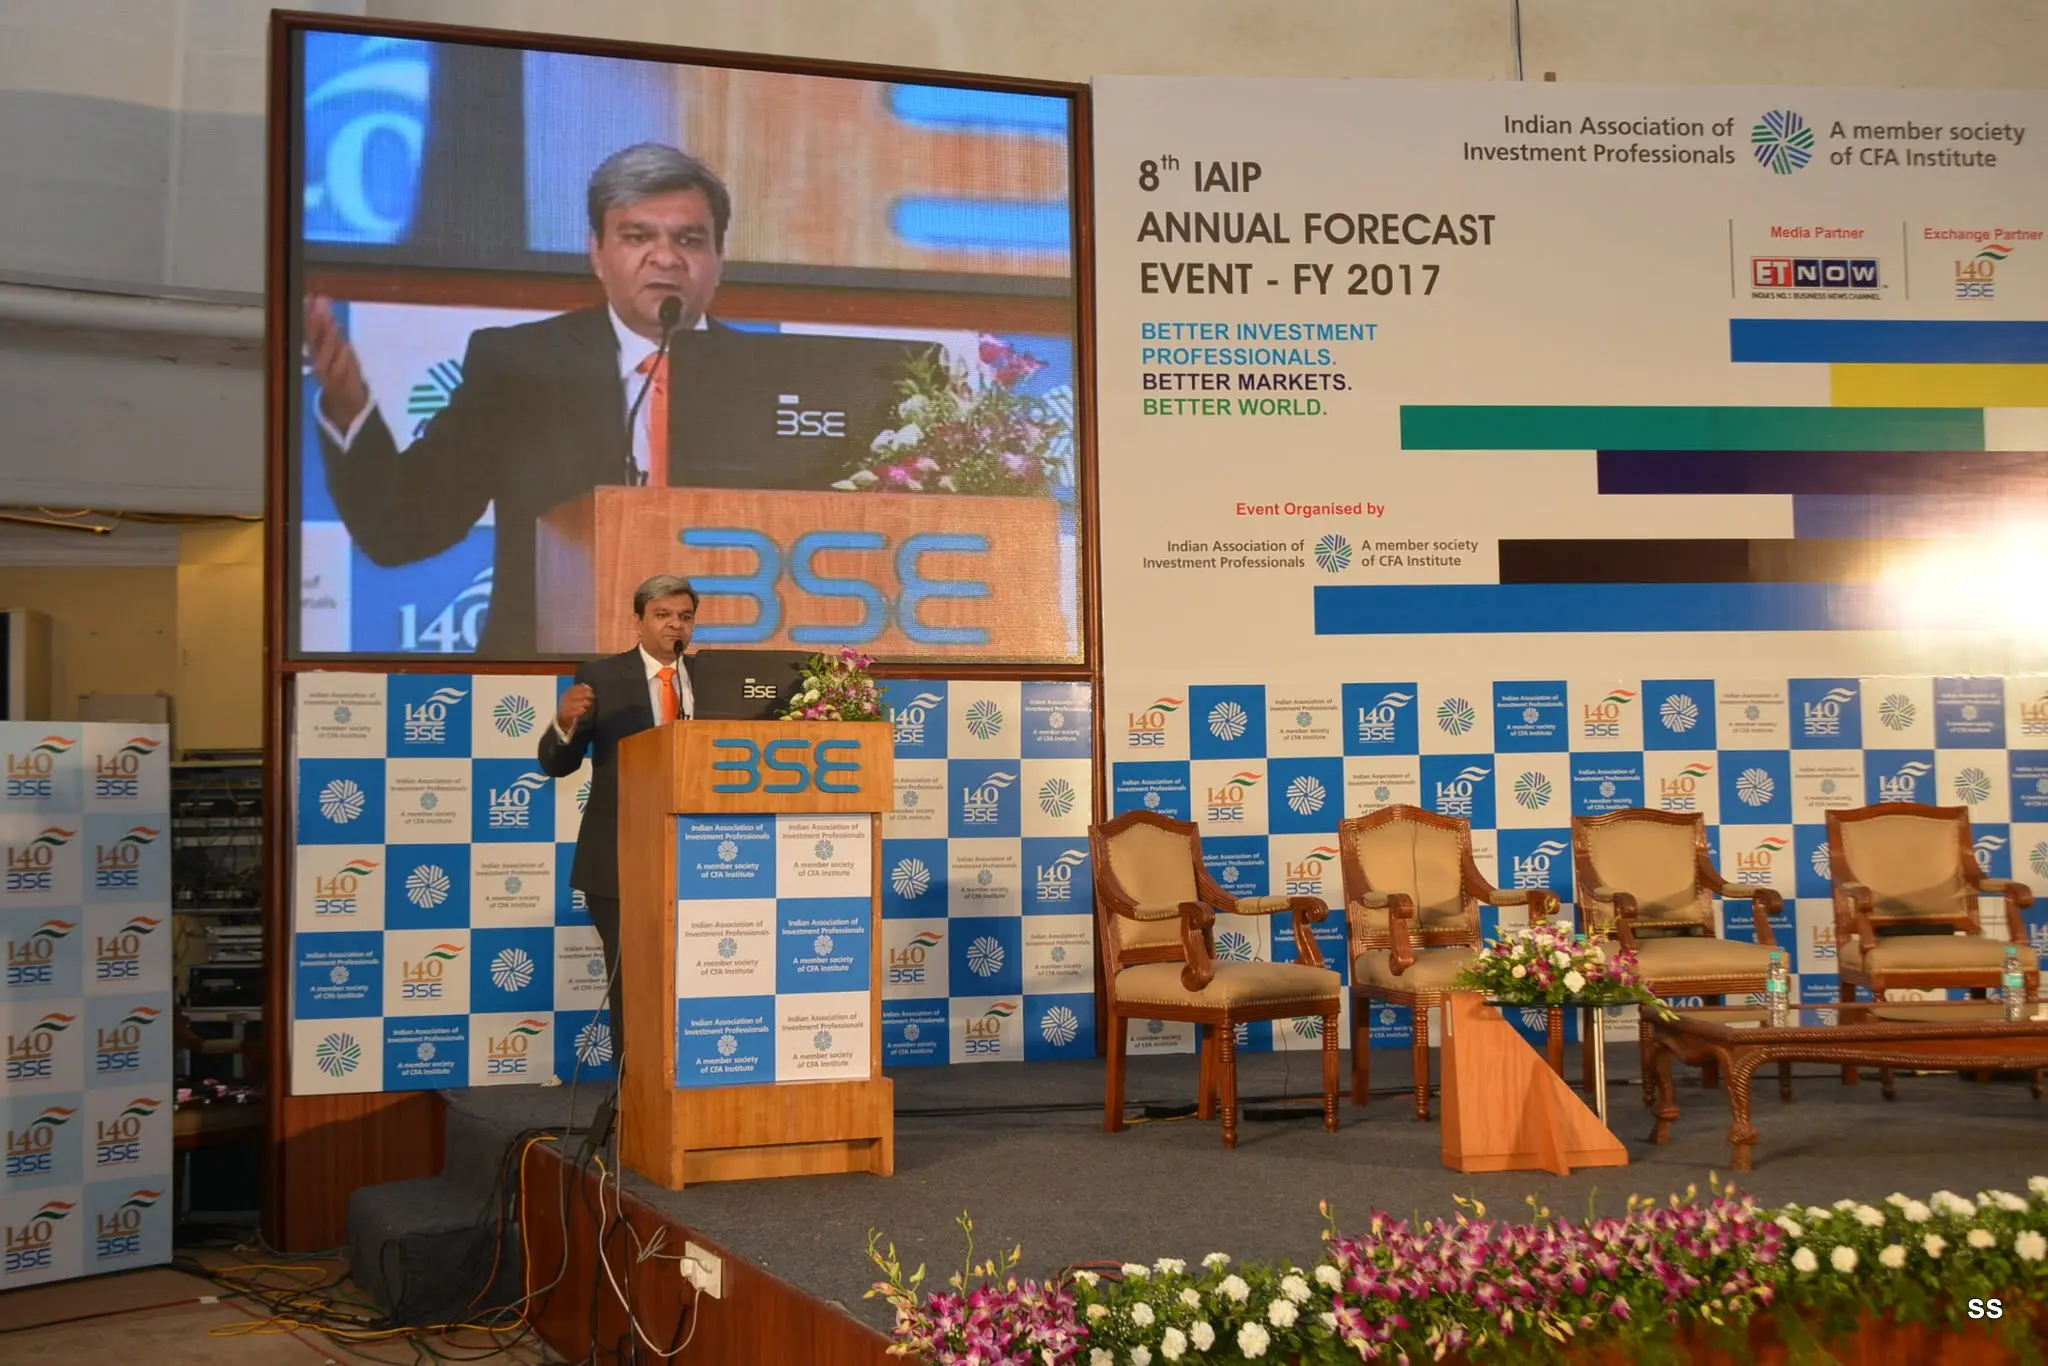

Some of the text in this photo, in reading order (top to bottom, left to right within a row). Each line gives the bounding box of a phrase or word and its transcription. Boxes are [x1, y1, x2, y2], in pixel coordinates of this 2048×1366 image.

[1504, 115, 1734, 136] Indian Association of
[1829, 121, 2026, 145] A member society
[1463, 142, 1736, 164] Investment Professionals
[1829, 147, 1997, 167] of CFA Institute
[1194, 161, 1262, 192] IAIP
[1137, 211, 1496, 245] ANNUAL FORECAST
[1771, 226, 1865, 239] Media Partner
[1924, 228, 2044, 242] Exchange Partner
[1140, 262, 1253, 294] EVENT
[1293, 263, 1335, 295] FY
[1347, 263, 1441, 296] 2017
[1141, 322, 1378, 341] BETTER INVESTMENT
[1141, 348, 1337, 366] PROFESSIONALS.
[1142, 373, 1352, 391] BETTER MARKETS.
[1143, 398, 1328, 416] BETTER WORLD.
[1236, 502, 1385, 518] Event Organised by
[1167, 539, 1305, 552] Indian Association of
[1361, 539, 1479, 554] A member society
[1142, 556, 1306, 569] Investment Professionals
[1361, 554, 1462, 567] of CFA Institute
[811, 823, 850, 831] Association
[725, 832, 770, 840] Professionals
[734, 863, 759, 871] society
[800, 861, 829, 869] member
[830, 862, 854, 870] society
[821, 927, 864, 935] Professionals
[830, 956, 853, 965] society
[685, 1026, 769, 1035] Investment Professionals
[703, 1057, 732, 1065] member
[734, 1057, 758, 1066] society
[725, 1064, 754, 1072] Institute
